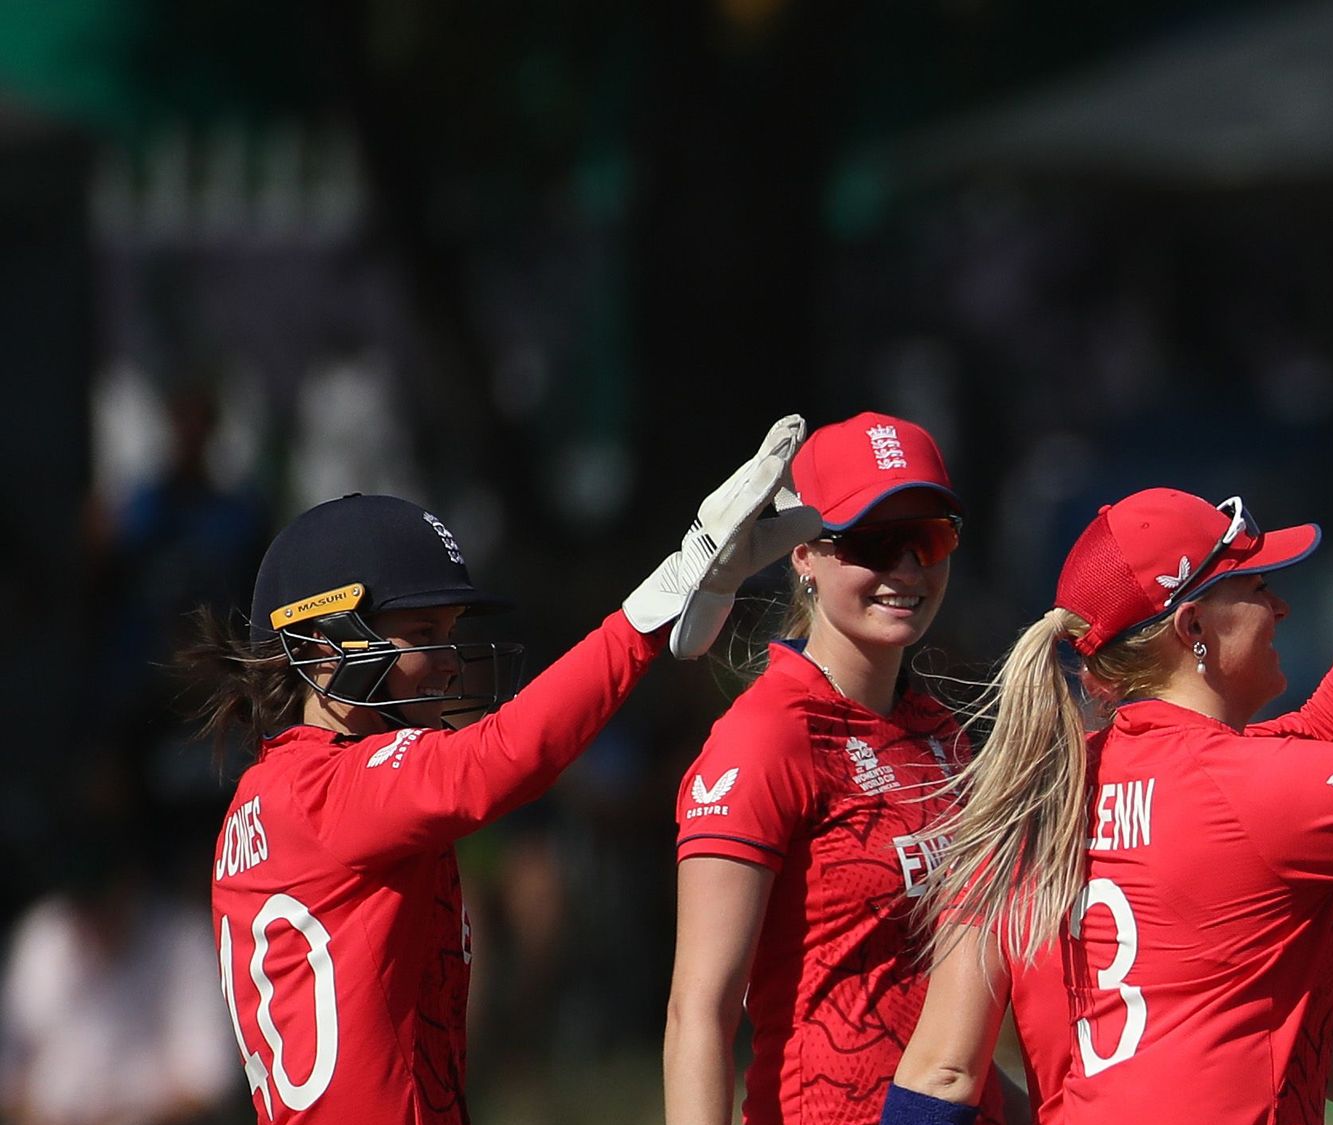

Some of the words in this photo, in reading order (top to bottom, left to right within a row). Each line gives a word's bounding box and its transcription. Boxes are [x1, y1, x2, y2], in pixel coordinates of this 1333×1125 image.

[298, 592, 347, 612] MASURI
[391, 728, 430, 769] CASTOR
[215, 795, 269, 882] JONES
[1086, 777, 1156, 851] ENN
[219, 892, 339, 1122] 40
